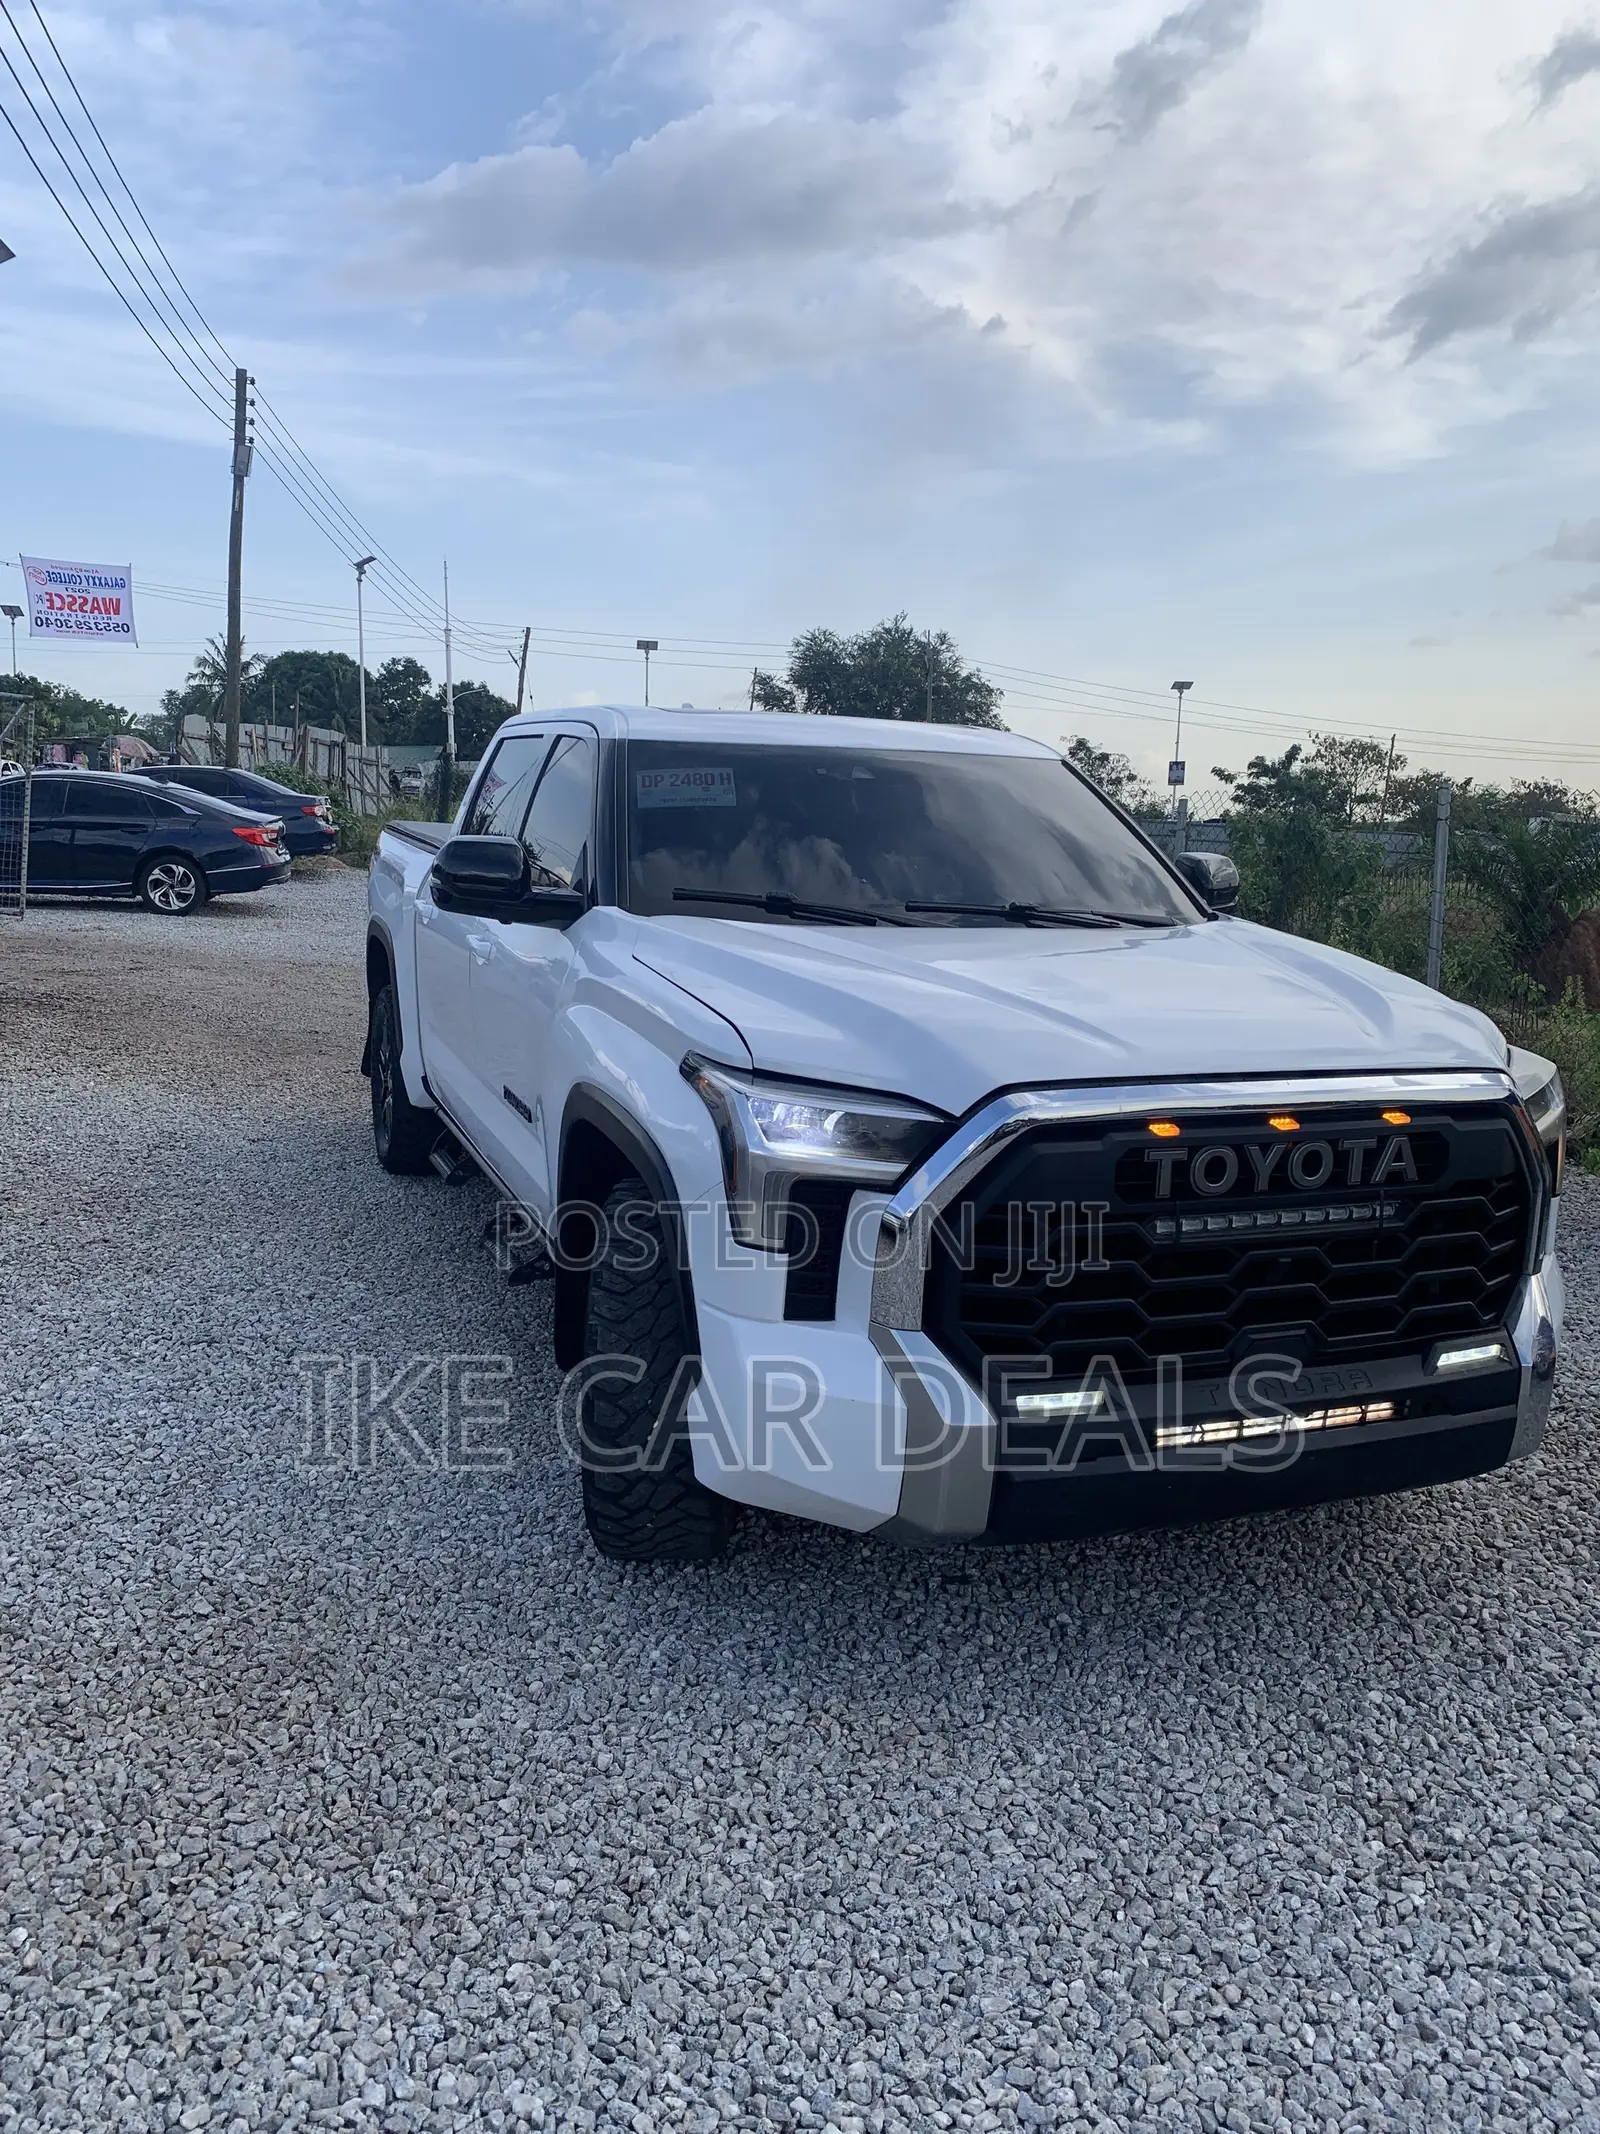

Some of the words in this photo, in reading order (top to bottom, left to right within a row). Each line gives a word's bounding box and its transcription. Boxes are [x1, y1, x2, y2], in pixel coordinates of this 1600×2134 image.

[641, 774, 664, 789] DP
[669, 772, 715, 787] 2480
[1143, 1134, 1419, 1199] TOYOTA
